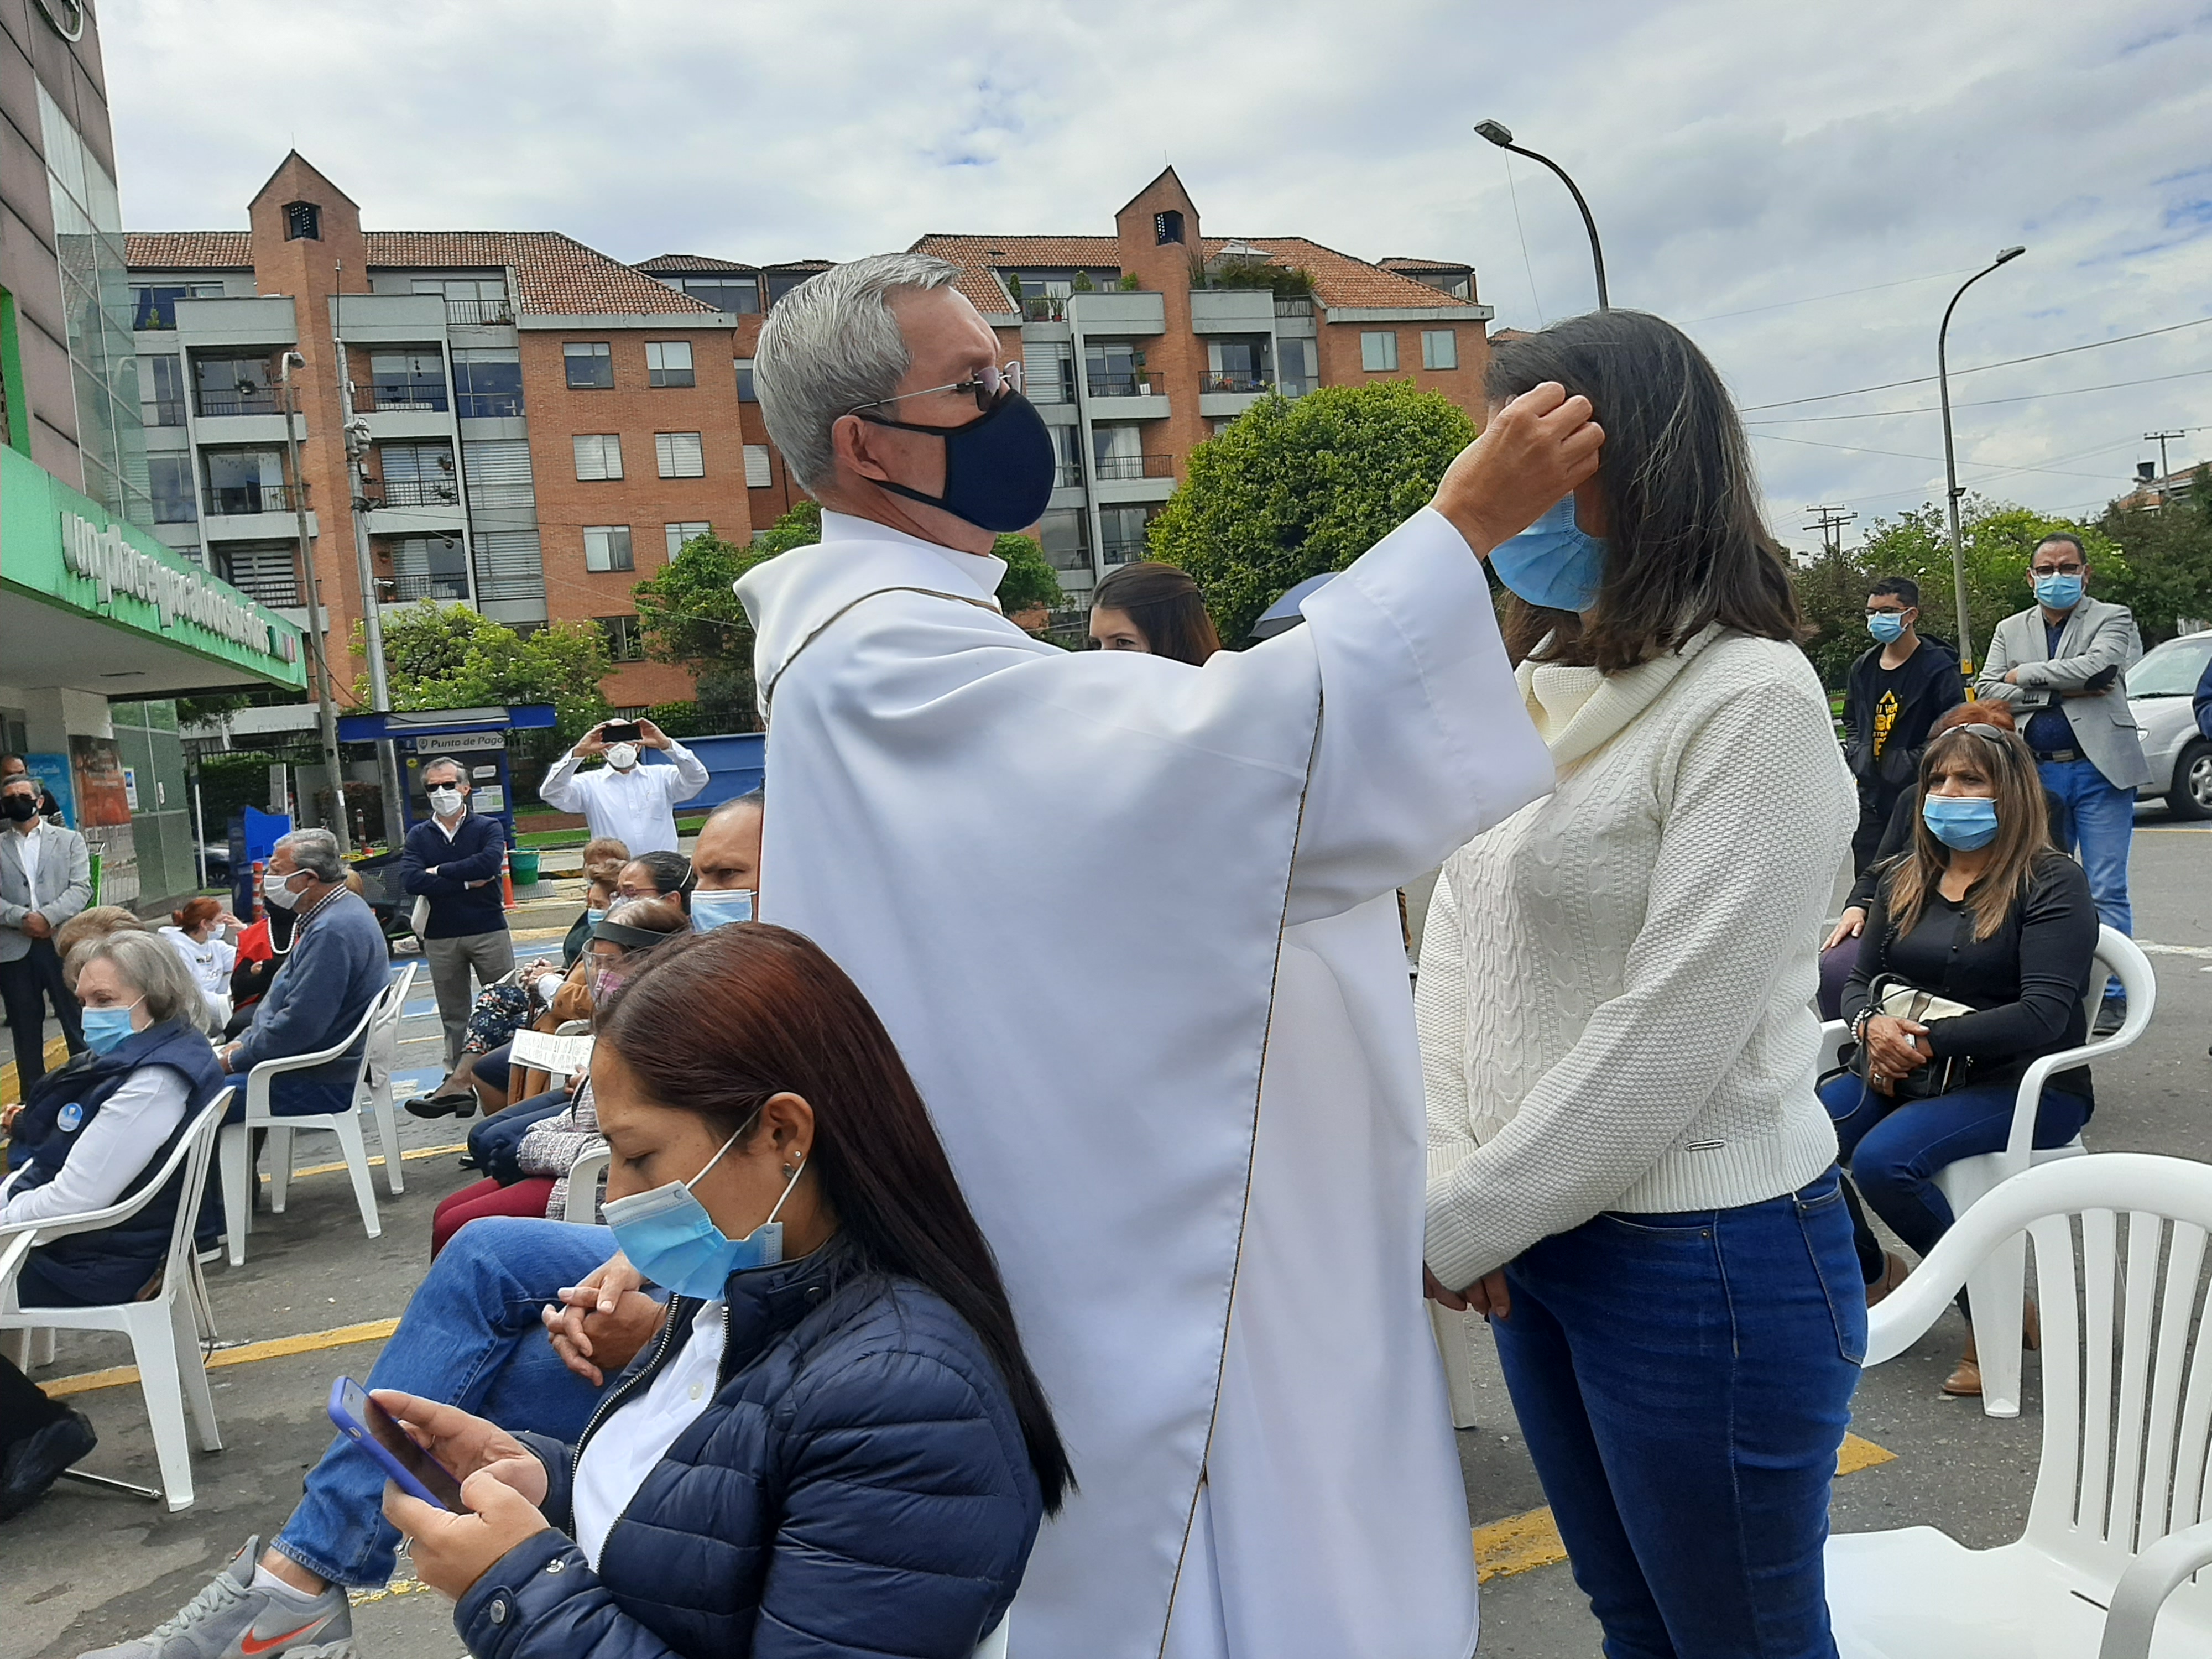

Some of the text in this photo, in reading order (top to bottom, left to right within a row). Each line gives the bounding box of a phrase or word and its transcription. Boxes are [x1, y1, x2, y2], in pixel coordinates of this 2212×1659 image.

[431, 736, 504, 748] Punto de Pago
